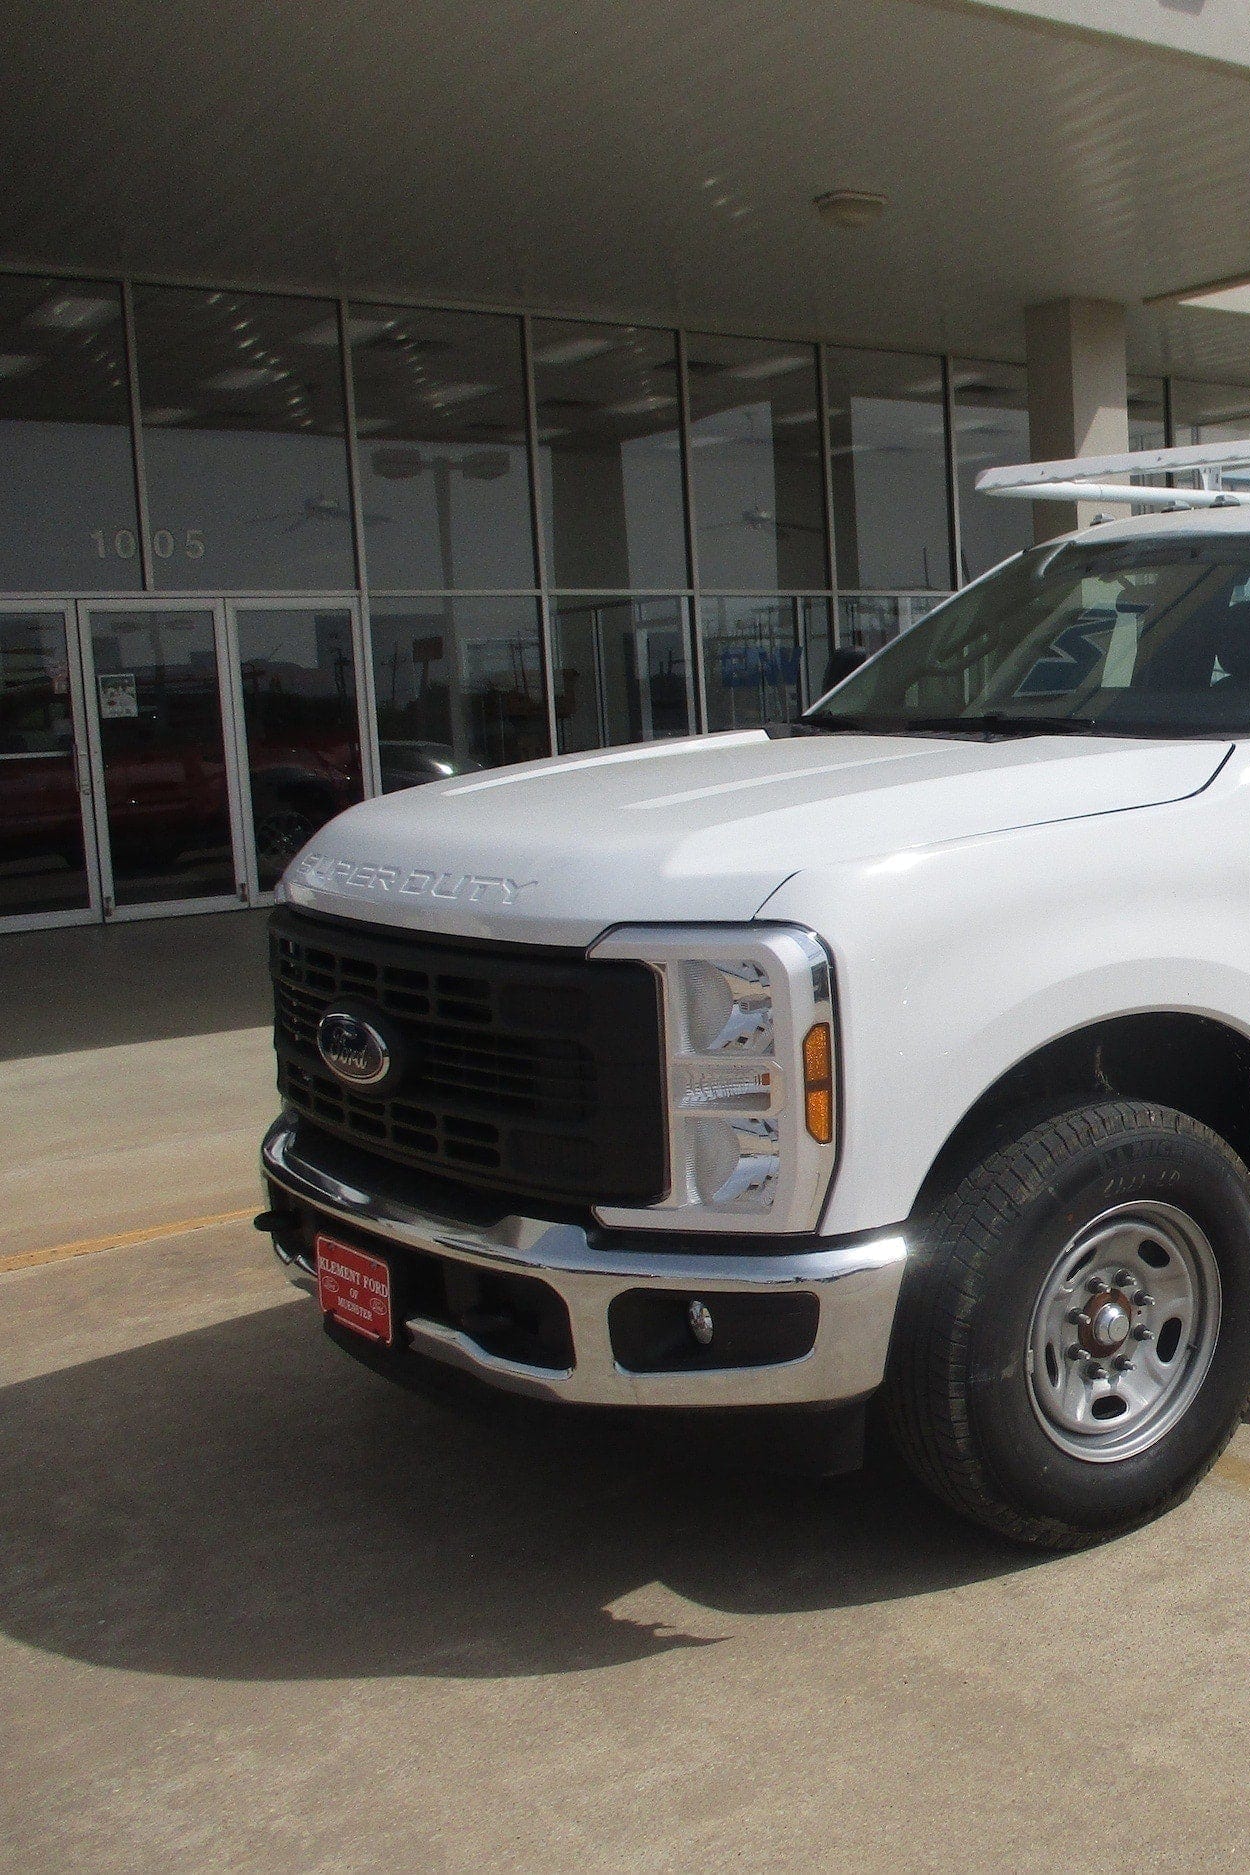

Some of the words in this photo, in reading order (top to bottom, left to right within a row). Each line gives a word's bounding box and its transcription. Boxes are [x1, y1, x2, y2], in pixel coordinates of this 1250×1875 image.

[90, 528, 206, 560] 1005
[296, 854, 401, 892] SUPER
[401, 869, 539, 905] DUTY
[319, 1256, 361, 1285] KLEMENT
[363, 1274, 388, 1298] FORD
[349, 1287, 359, 1300] OF
